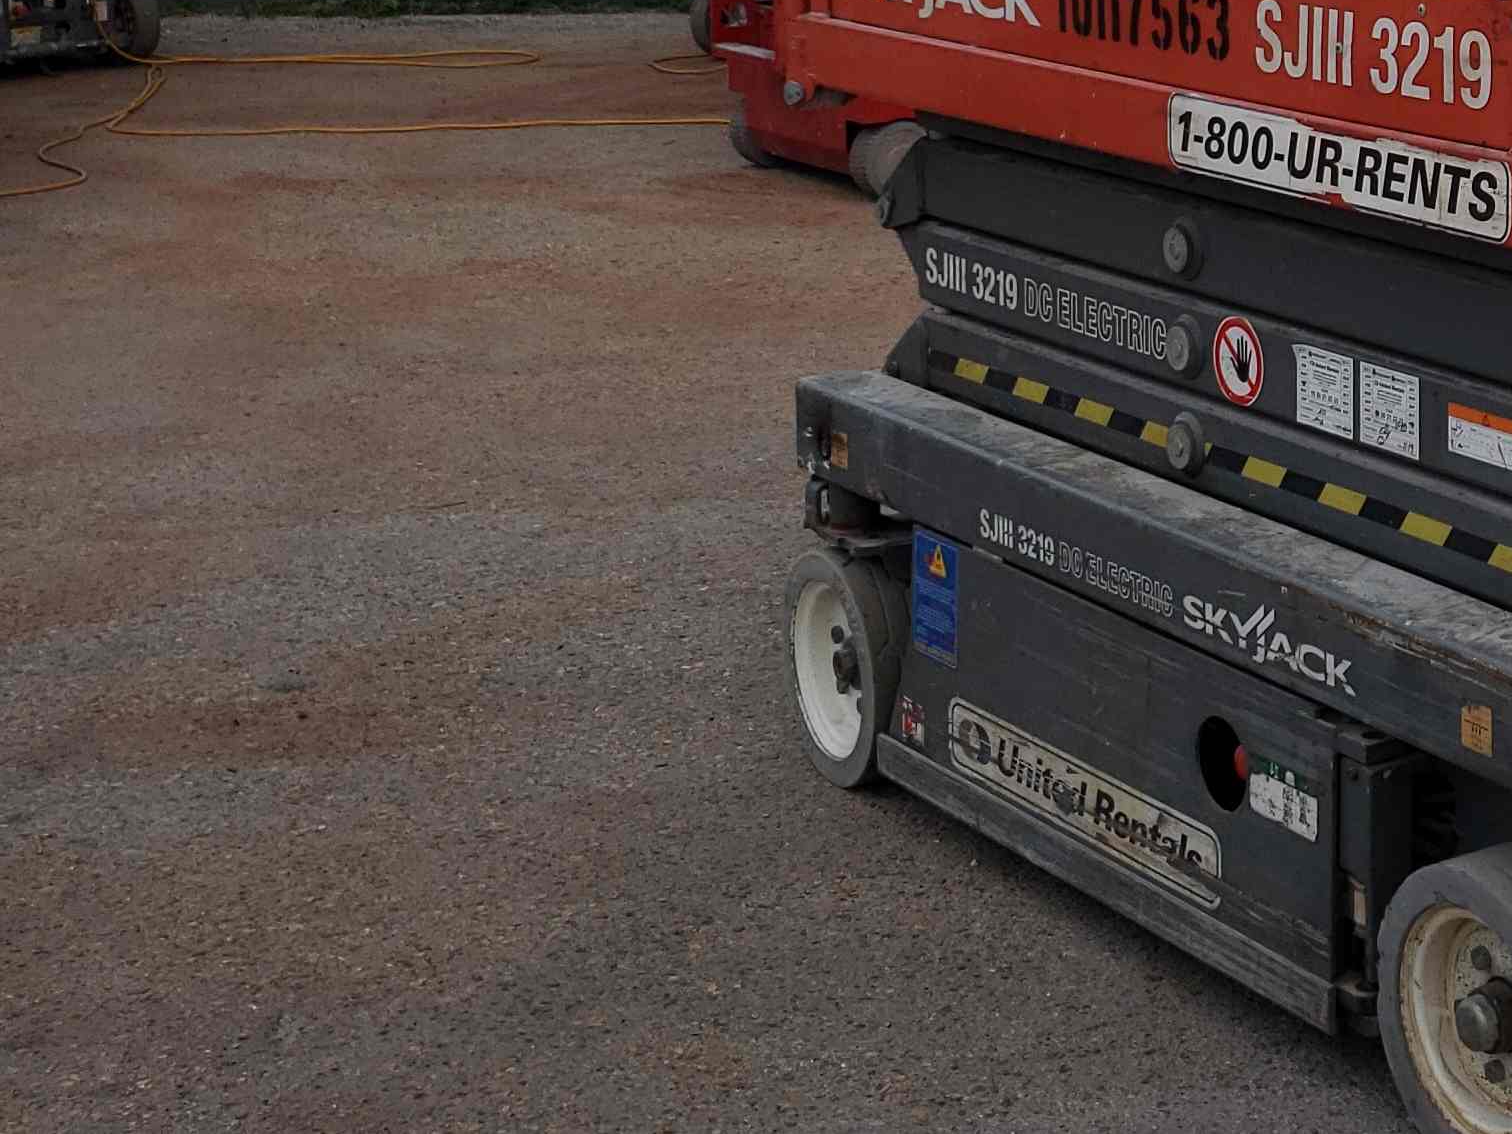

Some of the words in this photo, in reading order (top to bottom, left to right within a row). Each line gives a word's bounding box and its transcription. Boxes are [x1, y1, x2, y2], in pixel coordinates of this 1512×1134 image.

[1369, 17, 1493, 110] 3219
[1178, 111, 1498, 222] 1-800-UR-RENTS
[926, 247, 967, 294] SJIII
[972, 263, 1018, 310] 3219
[1024, 277, 1053, 322] DC
[1056, 288, 1167, 360] ELECTRIC
[1017, 525, 1055, 566] 3219
[1085, 552, 1174, 617] ELECTRIC
[1182, 594, 1357, 697] SKYJACK
